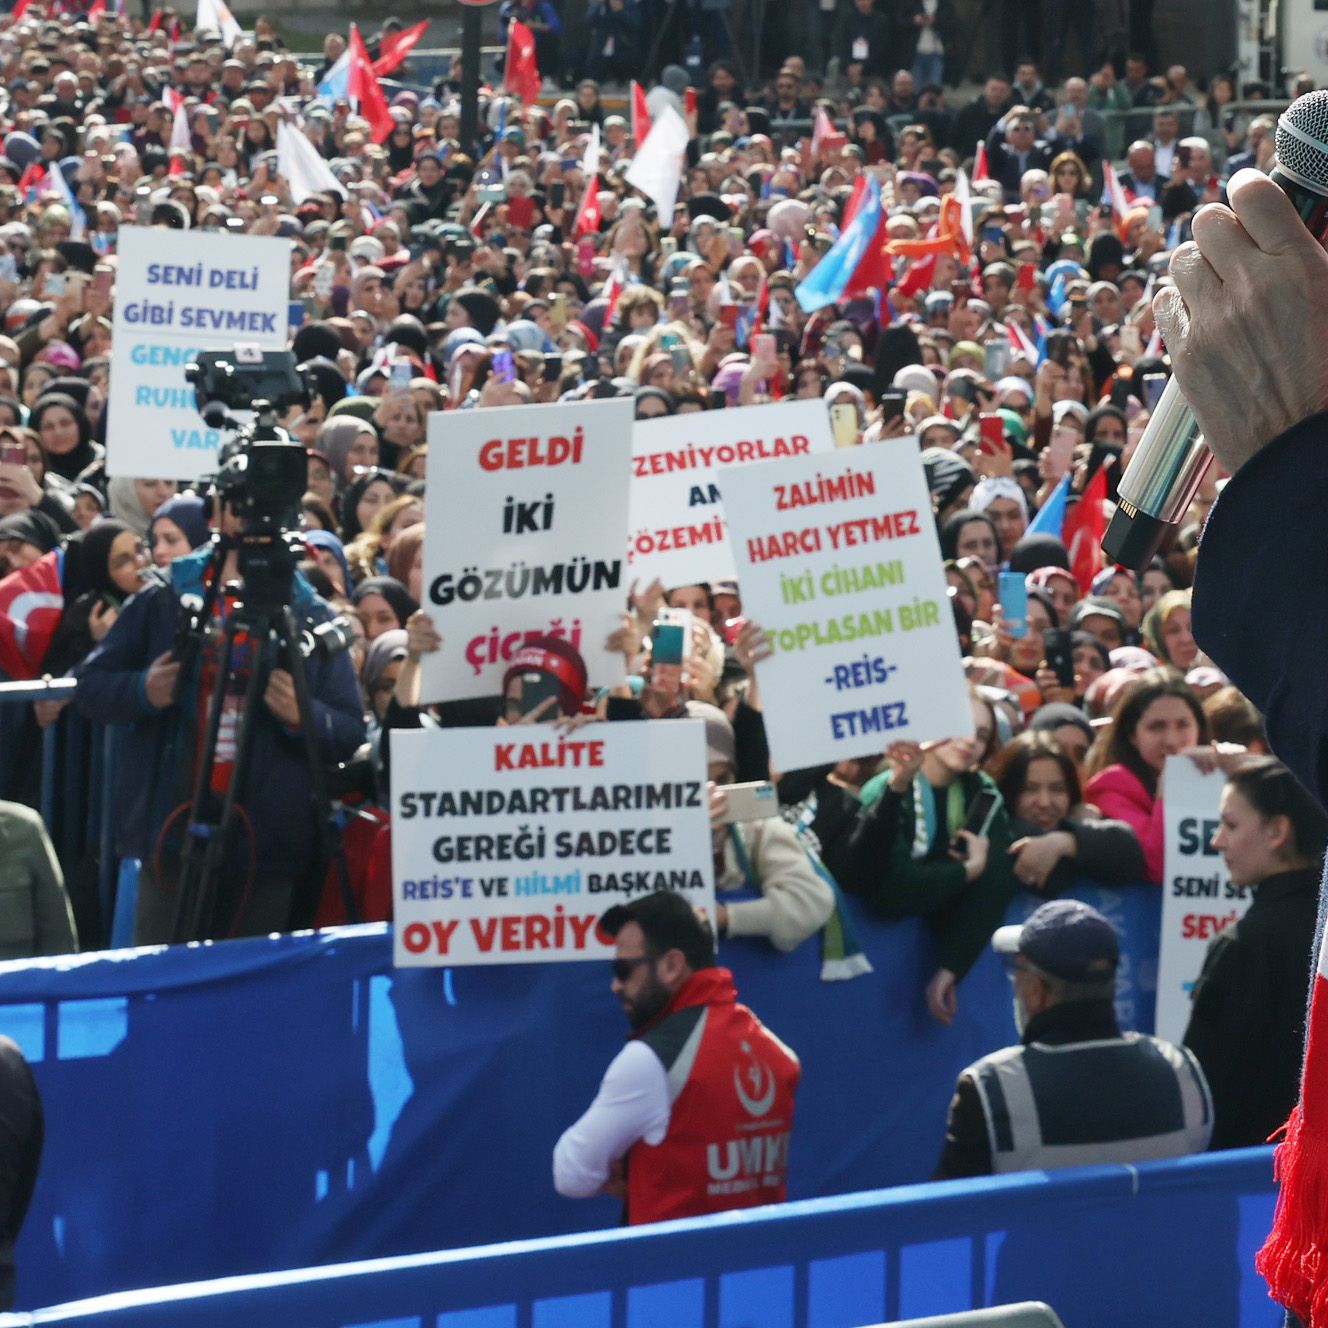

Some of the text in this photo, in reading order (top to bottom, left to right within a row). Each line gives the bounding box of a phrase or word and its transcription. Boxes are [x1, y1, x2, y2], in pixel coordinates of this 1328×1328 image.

[147, 261, 259, 291] SENİ DELİ
[123, 299, 277, 334] GİBİ SEVMEK
[170, 428, 222, 450] VAR
[479, 426, 586, 472] GELDİ
[774, 468, 877, 511] ZALİMİN
[502, 493, 555, 535] İKİ
[627, 515, 727, 565] ÖZEMİ
[747, 510, 922, 564] HARCI YETMEZ
[430, 556, 622, 606] GÖZÜMÜN
[779, 559, 906, 604] İKİ CİHANI
[762, 595, 941, 653] TOPLASAN BİR
[824, 652, 897, 691] -REİS-
[830, 701, 909, 740] ETMEZ
[494, 735, 606, 772] KALİTE
[400, 782, 702, 819] STANDARTLARIMIZ
[432, 825, 672, 864] GEREĞİ SADECE
[402, 869, 705, 900] REİS'E VE HİLMİ BAŞKANA
[1173, 873, 1220, 898] SENİ
[403, 919, 460, 956] OY
